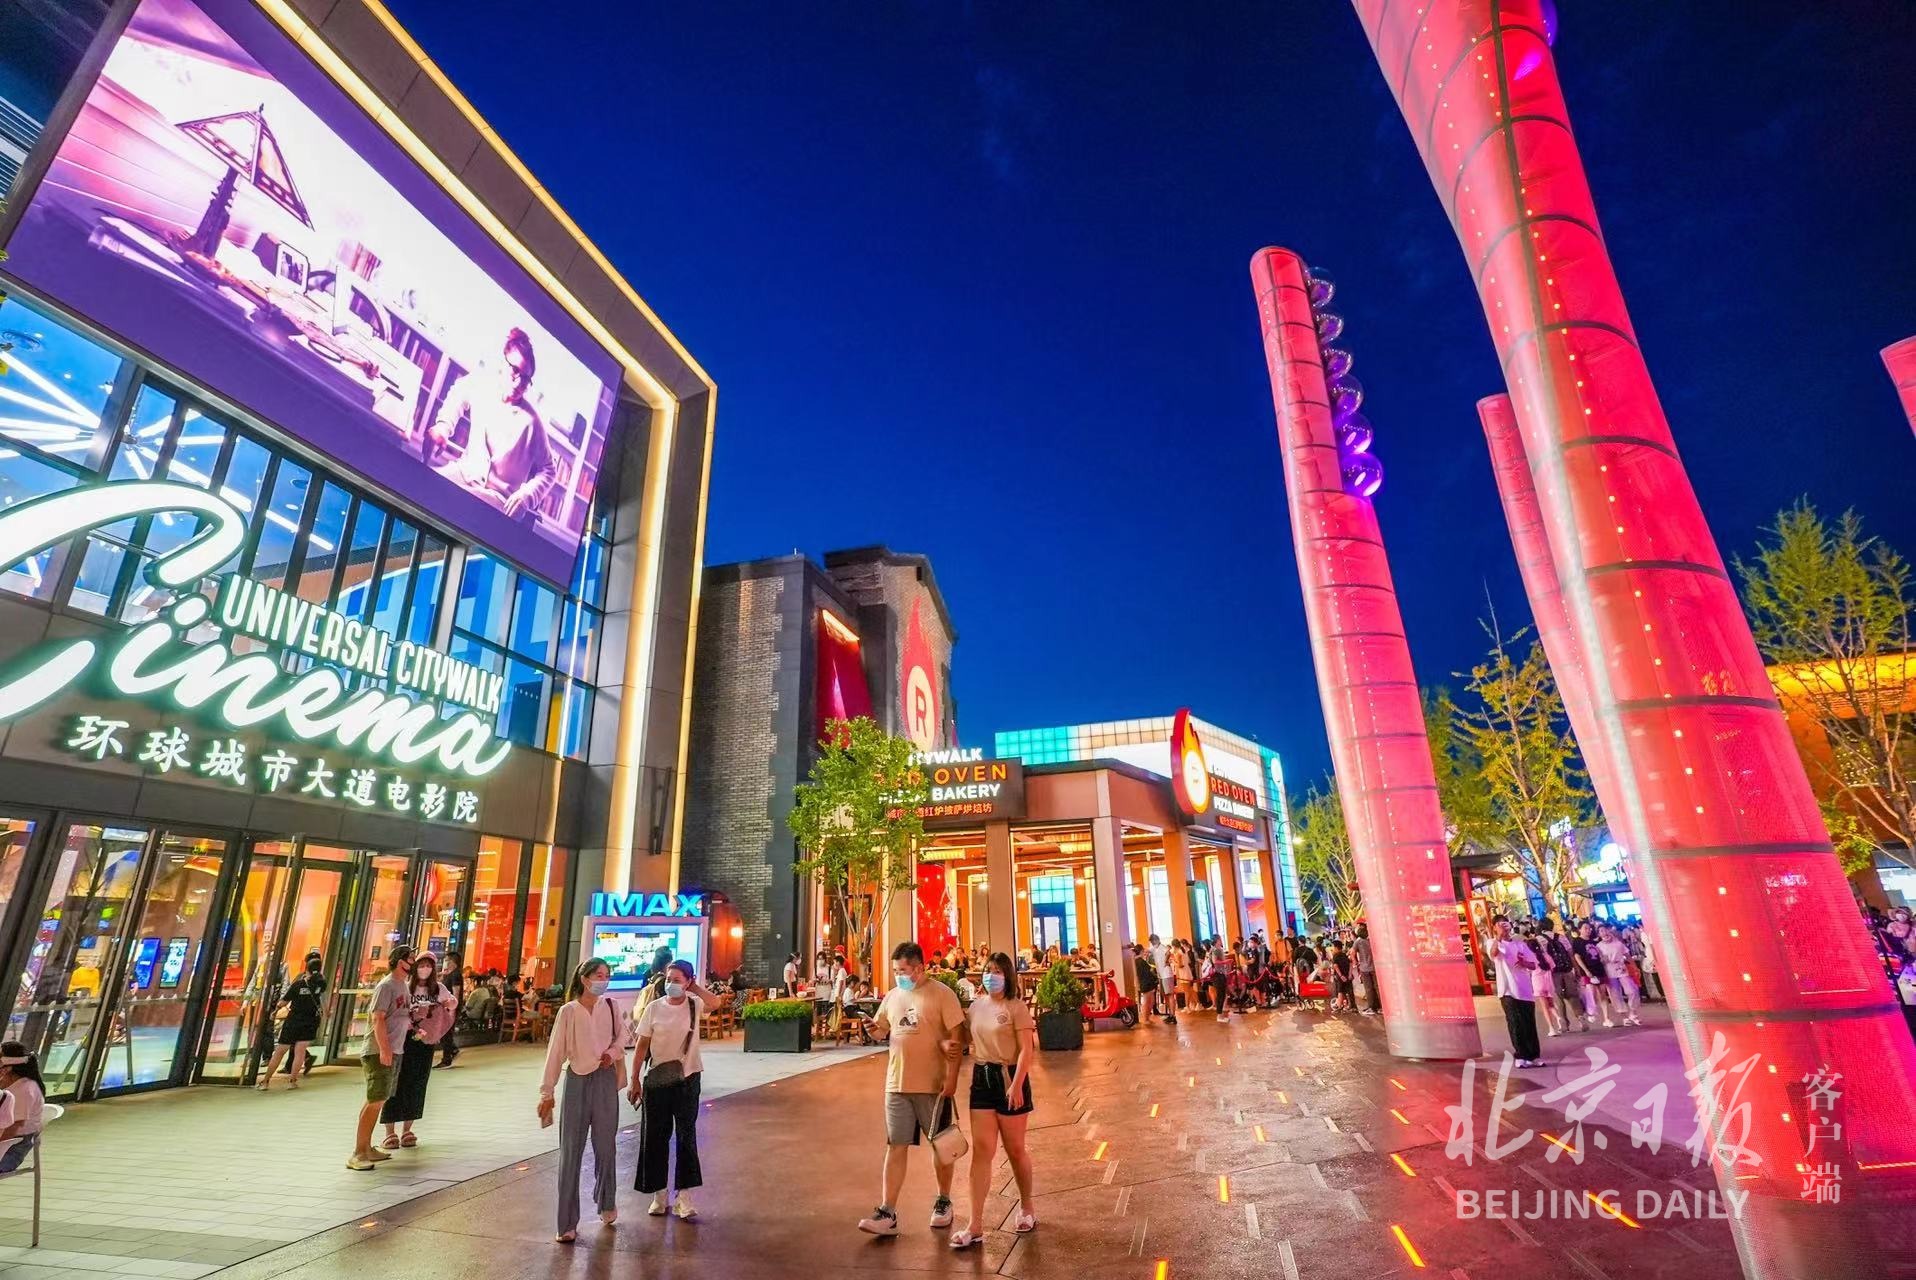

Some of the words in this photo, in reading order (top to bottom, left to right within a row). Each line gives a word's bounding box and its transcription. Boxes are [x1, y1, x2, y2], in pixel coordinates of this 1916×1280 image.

[0, 481, 512, 777] Cinema
[222, 574, 390, 678] UNIVERSAL
[396, 640, 504, 714] CITYWALK
[916, 685, 928, 738] R
[67, 715, 479, 824] 环球城市大道电影院
[934, 763, 1008, 785] OVEN
[931, 783, 1001, 801] BAKERY
[1209, 776, 1230, 797] RED
[1231, 784, 1256, 806] OVEN
[592, 892, 706, 917] IMAX
